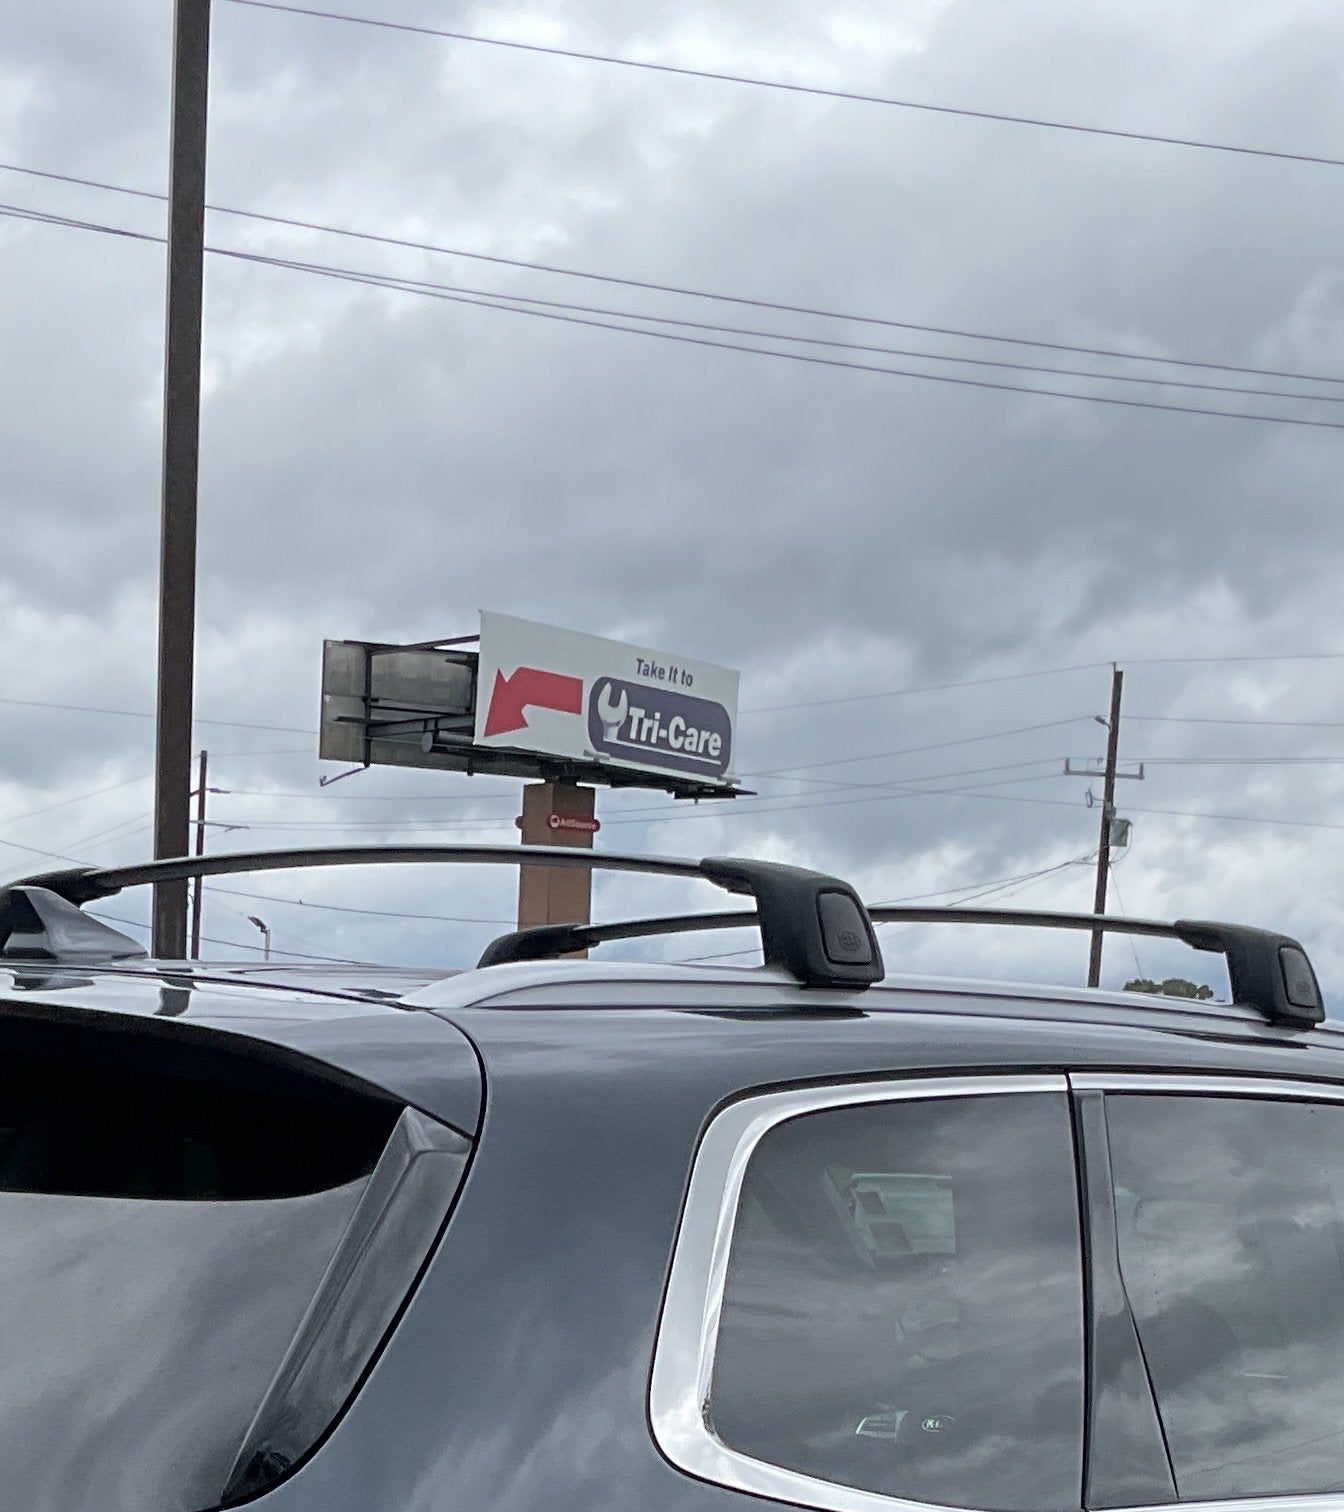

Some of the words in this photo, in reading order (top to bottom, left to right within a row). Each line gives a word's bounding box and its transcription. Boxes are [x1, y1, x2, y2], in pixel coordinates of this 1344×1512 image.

[636, 657, 665, 680] Take
[668, 666, 678, 684] It
[681, 669, 694, 687] to
[629, 706, 722, 757] Tri-Care
